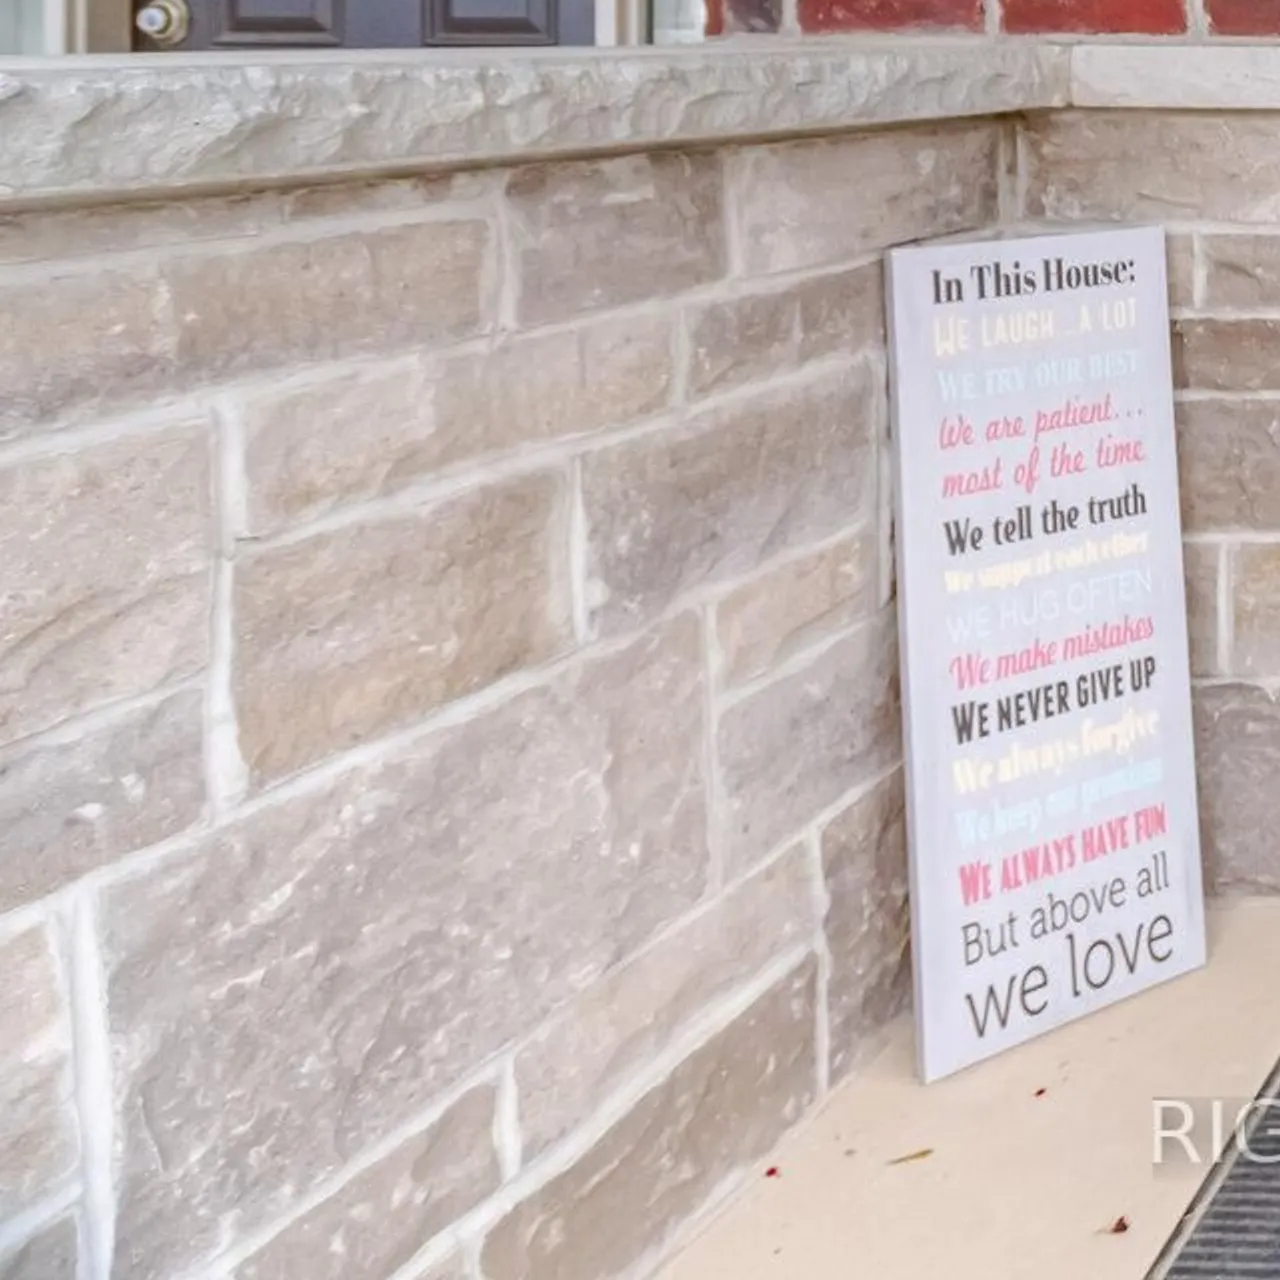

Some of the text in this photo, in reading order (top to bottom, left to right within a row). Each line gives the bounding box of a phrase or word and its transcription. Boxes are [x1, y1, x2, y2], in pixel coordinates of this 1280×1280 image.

[931, 257, 1136, 305] In This House:
[935, 315, 969, 357] WE
[1101, 297, 1137, 331] LOT
[940, 415, 975, 450] We
[985, 415, 1025, 440] are
[941, 433, 1146, 499] most of the time
[943, 483, 1147, 556] We tell the truth
[949, 614, 1155, 691] We make mistakes
[951, 655, 1157, 745] WE NEVER GIVE UP
[959, 861, 993, 907] WE
[1000, 835, 1077, 893] ALWAYS
[1082, 816, 1130, 864] HAVE
[1134, 803, 1168, 844] FUN
[961, 850, 1171, 967] But above all
[965, 913, 1175, 1038] we love
